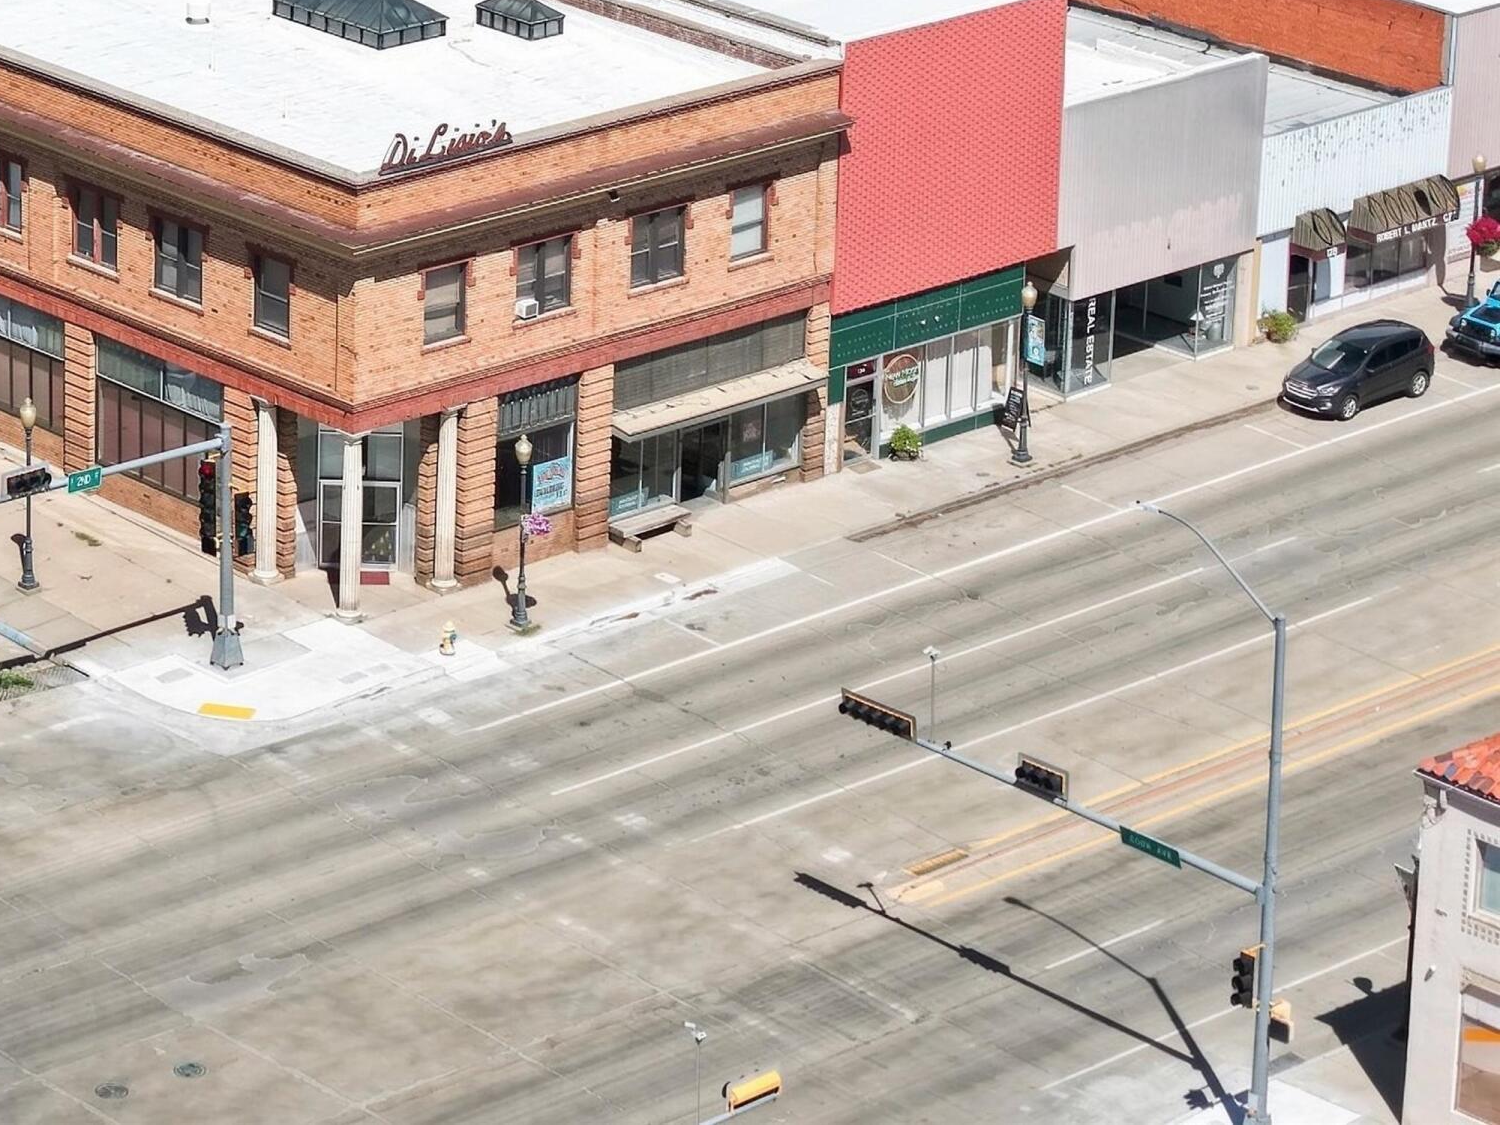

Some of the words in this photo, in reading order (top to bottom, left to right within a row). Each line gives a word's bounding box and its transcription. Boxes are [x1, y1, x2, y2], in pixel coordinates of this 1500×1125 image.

[1376, 228, 1402, 243] ROBERT
[1086, 297, 1097, 334] REAL
[1083, 334, 1095, 385] ESTATE
